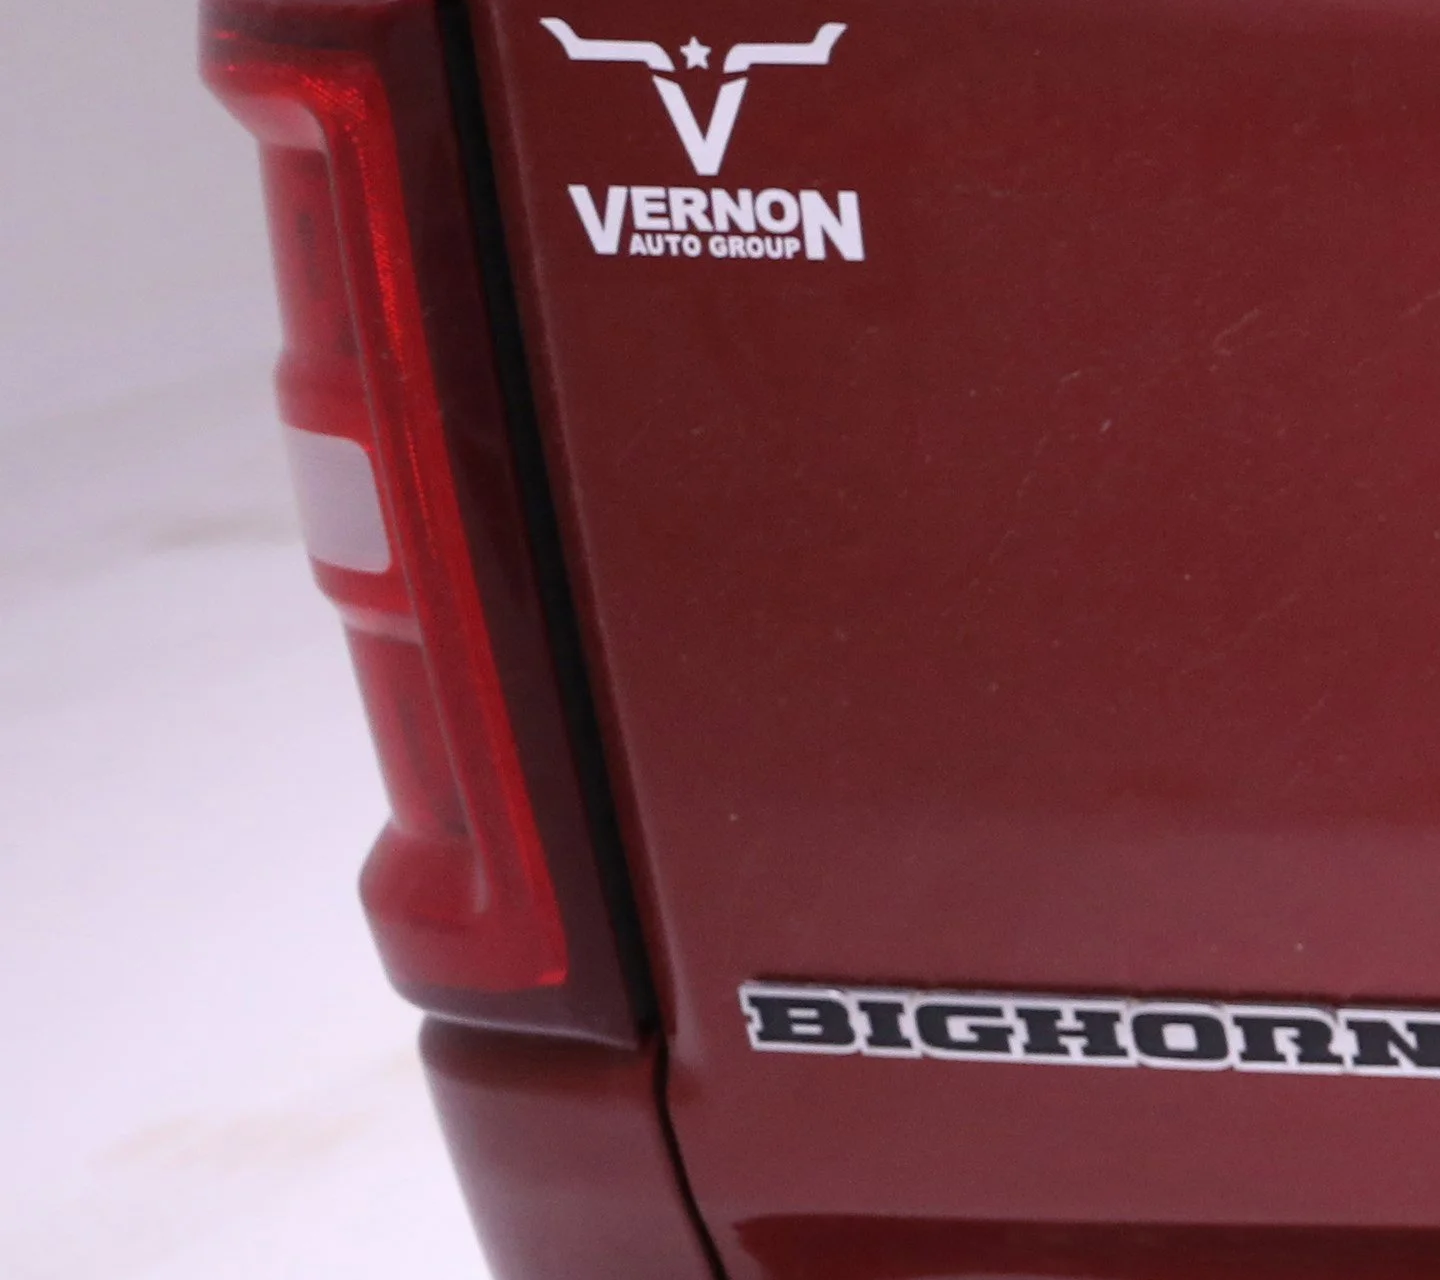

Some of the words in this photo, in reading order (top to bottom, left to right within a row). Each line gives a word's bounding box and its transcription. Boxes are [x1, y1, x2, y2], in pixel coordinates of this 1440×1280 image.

[567, 184, 866, 261] VERNON
[629, 233, 701, 257] AUTO
[708, 235, 801, 259] GROUP
